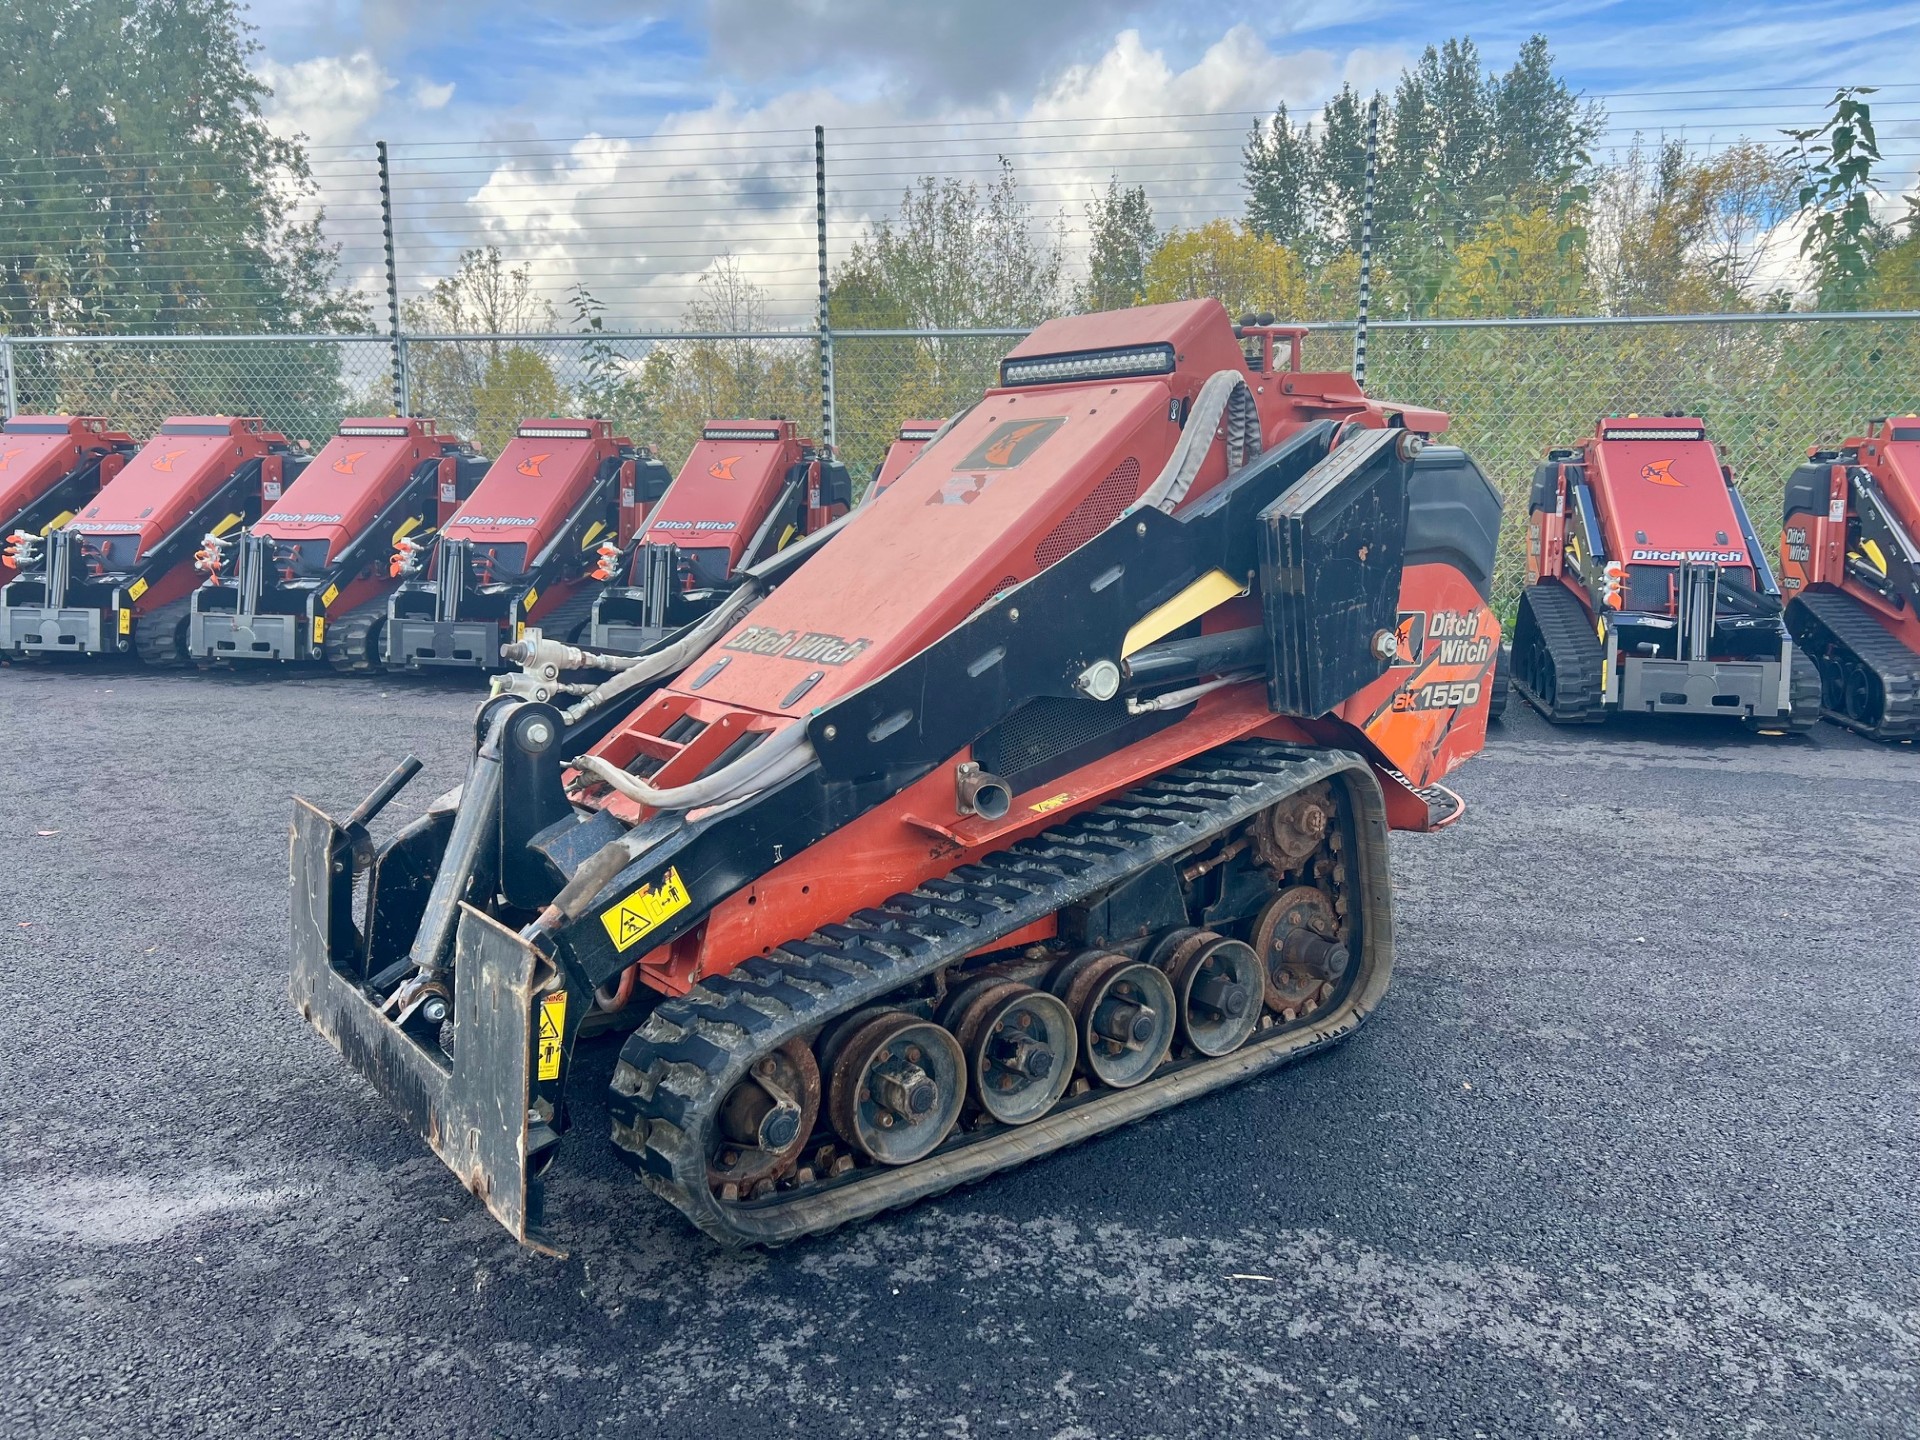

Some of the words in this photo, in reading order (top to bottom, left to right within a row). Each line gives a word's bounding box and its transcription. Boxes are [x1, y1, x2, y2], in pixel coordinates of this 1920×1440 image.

[264, 513, 302, 522] Ditch
[303, 514, 341, 522] Witch
[456, 516, 494, 525] Ditch
[495, 517, 536, 525] Witch
[653, 521, 693, 529] Ditch
[694, 522, 736, 530] Witch
[1786, 528, 1806, 544] Ditch
[1632, 550, 1684, 561] Ditch
[1686, 551, 1742, 562] Witch
[1789, 545, 1810, 561] Witch
[1783, 578, 1801, 588] 1050
[1429, 612, 1478, 636] Ditch
[724, 627, 796, 654] Ditch
[785, 634, 867, 663] Witch
[1440, 638, 1489, 664] Witch
[1420, 682, 1481, 707] 1550
